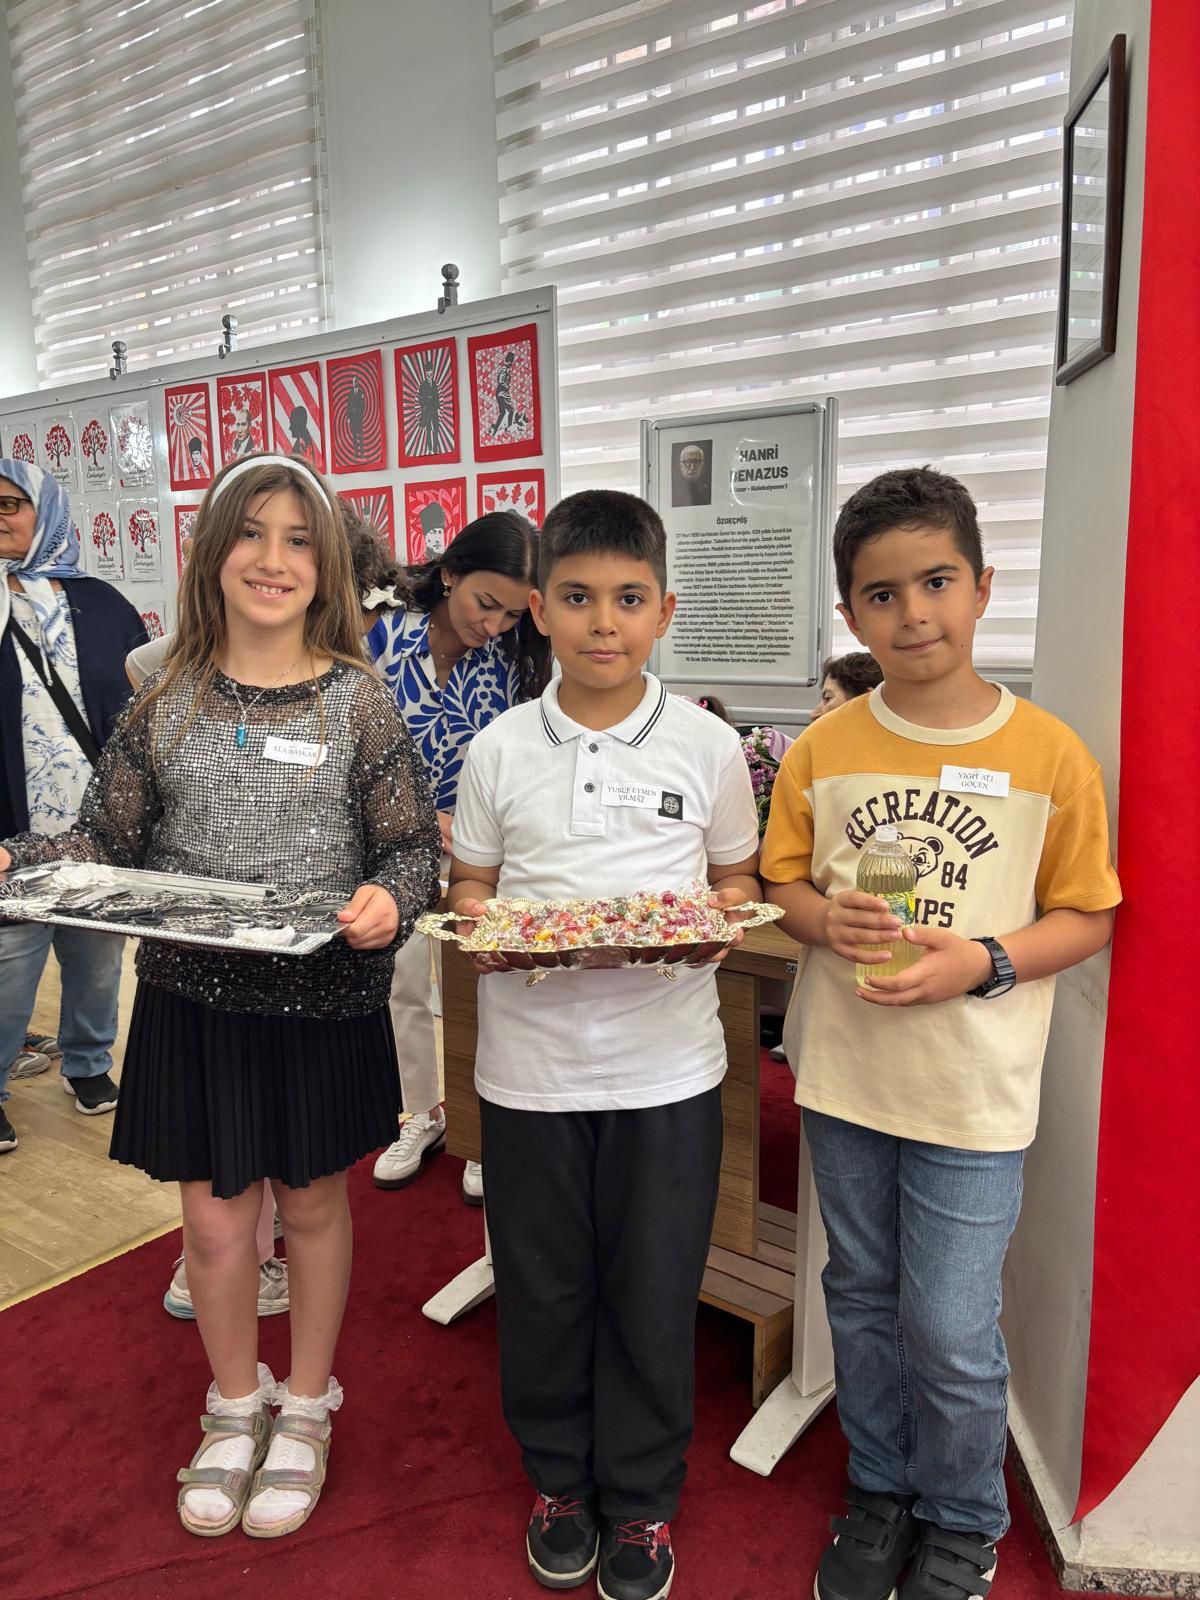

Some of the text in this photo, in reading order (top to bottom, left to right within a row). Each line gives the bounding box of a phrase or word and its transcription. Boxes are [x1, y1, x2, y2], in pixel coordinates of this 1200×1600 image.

[740, 444, 778, 462] HANRİ
[717, 516, 747, 525] ÖZGEÇMİŞ
[608, 785, 656, 796] YUSUF EYMEN
[845, 789, 999, 859] RECREATION
[941, 861, 968, 890] 84
